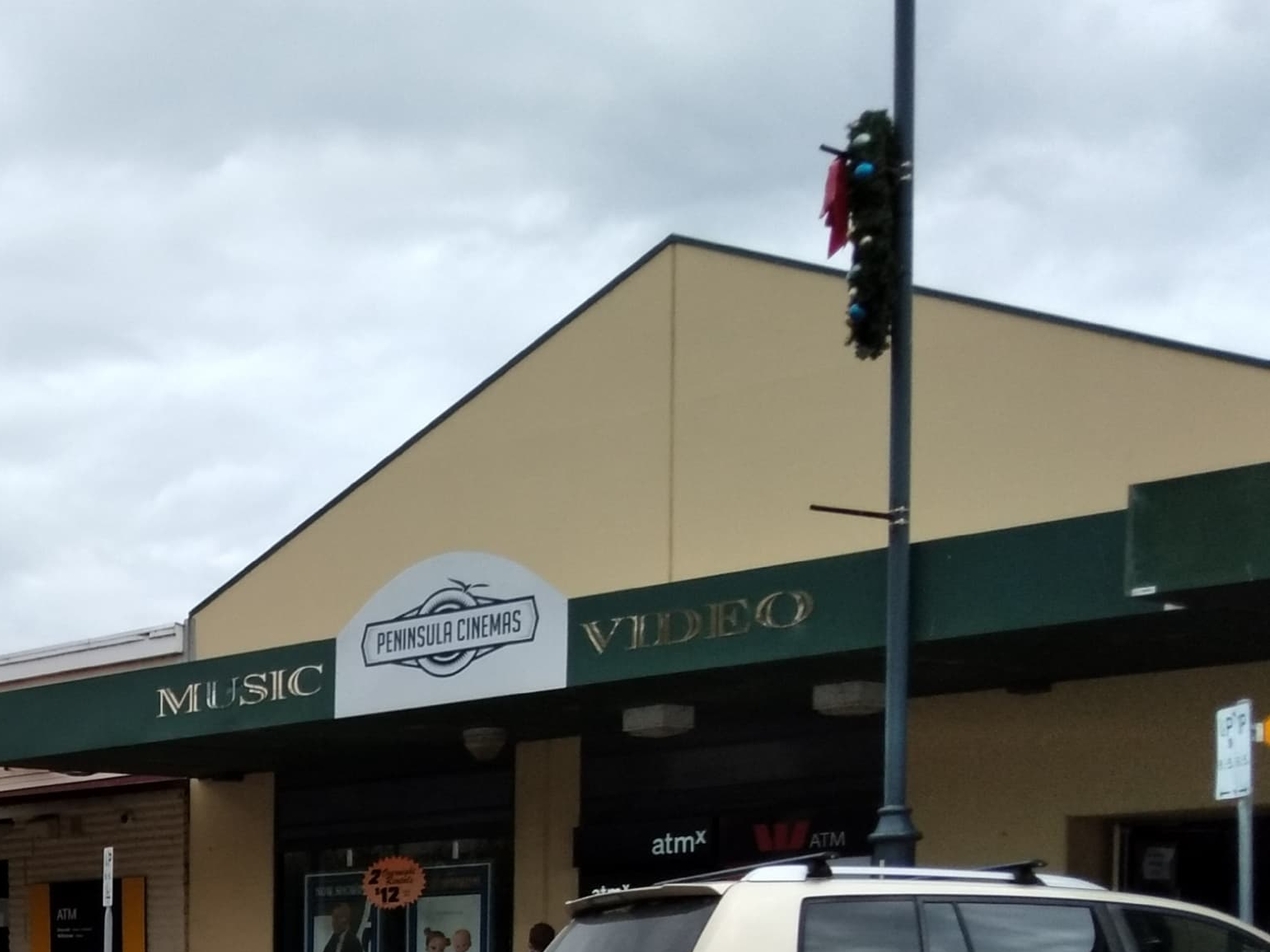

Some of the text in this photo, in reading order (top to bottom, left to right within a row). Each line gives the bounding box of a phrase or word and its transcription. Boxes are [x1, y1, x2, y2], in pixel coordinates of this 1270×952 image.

[376, 609, 522, 655] PENINSULA CINEMAS
[580, 590, 815, 655] VIDEO
[155, 663, 324, 719] MUSIC
[808, 831, 846, 849] ATM
[368, 868, 382, 885] 2
[56, 908, 78, 921] ATM
